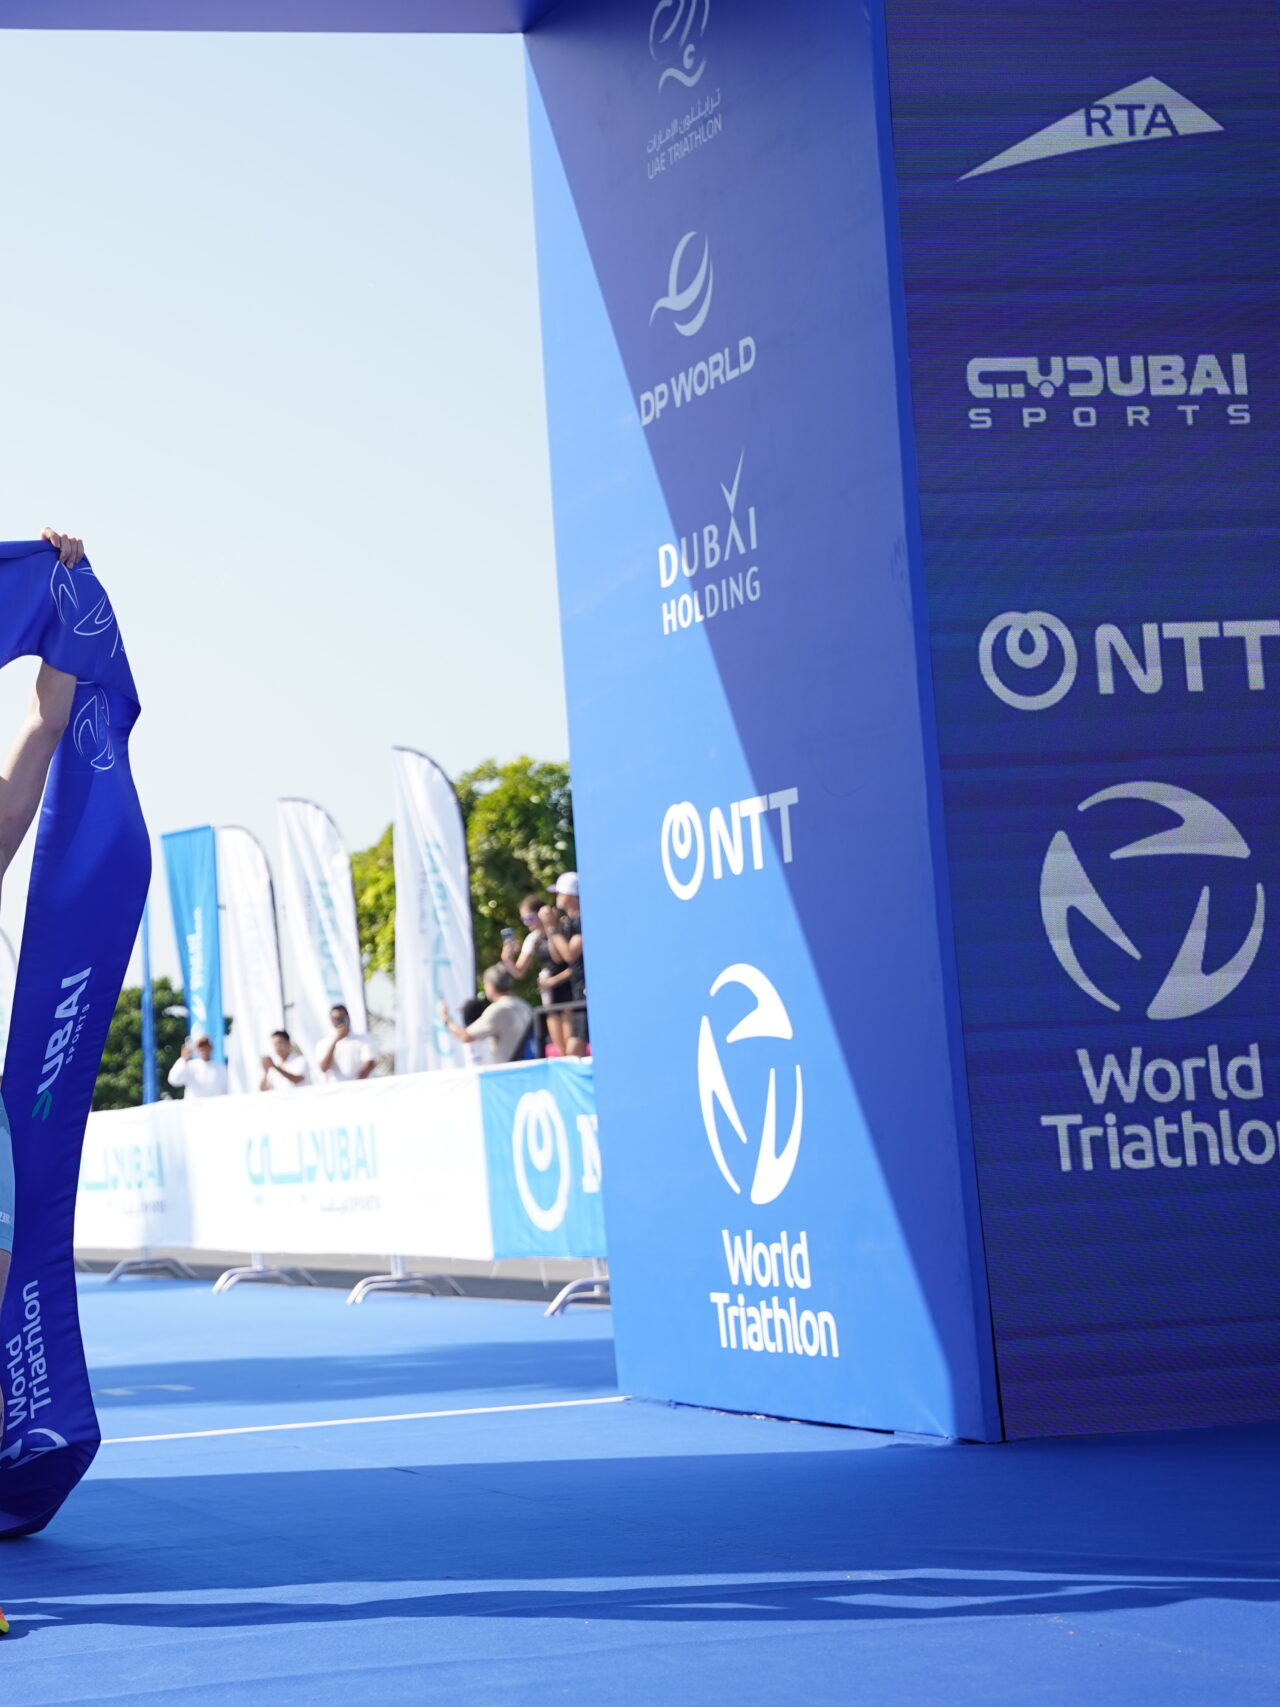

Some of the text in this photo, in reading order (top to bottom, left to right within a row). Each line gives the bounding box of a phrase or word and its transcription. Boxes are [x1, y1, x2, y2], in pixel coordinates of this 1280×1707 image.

[647, 113, 722, 180] UAE TRIATHLON
[1084, 104, 1179, 138] RTA
[639, 336, 756, 428] DP WORLD
[968, 404, 1251, 429] SPORTS
[662, 566, 761, 635] HOLDING
[1095, 620, 1280, 694] NTT
[709, 787, 799, 880] NTT
[65, 1003, 90, 1064] SPORTS
[1076, 1043, 1264, 1105] World
[1040, 1108, 1280, 1172] Triathlo
[721, 1229, 812, 1290] World
[22, 1280, 52, 1419] Triathlon
[709, 1292, 840, 1358] Triathlon
[6, 1334, 27, 1431] World
